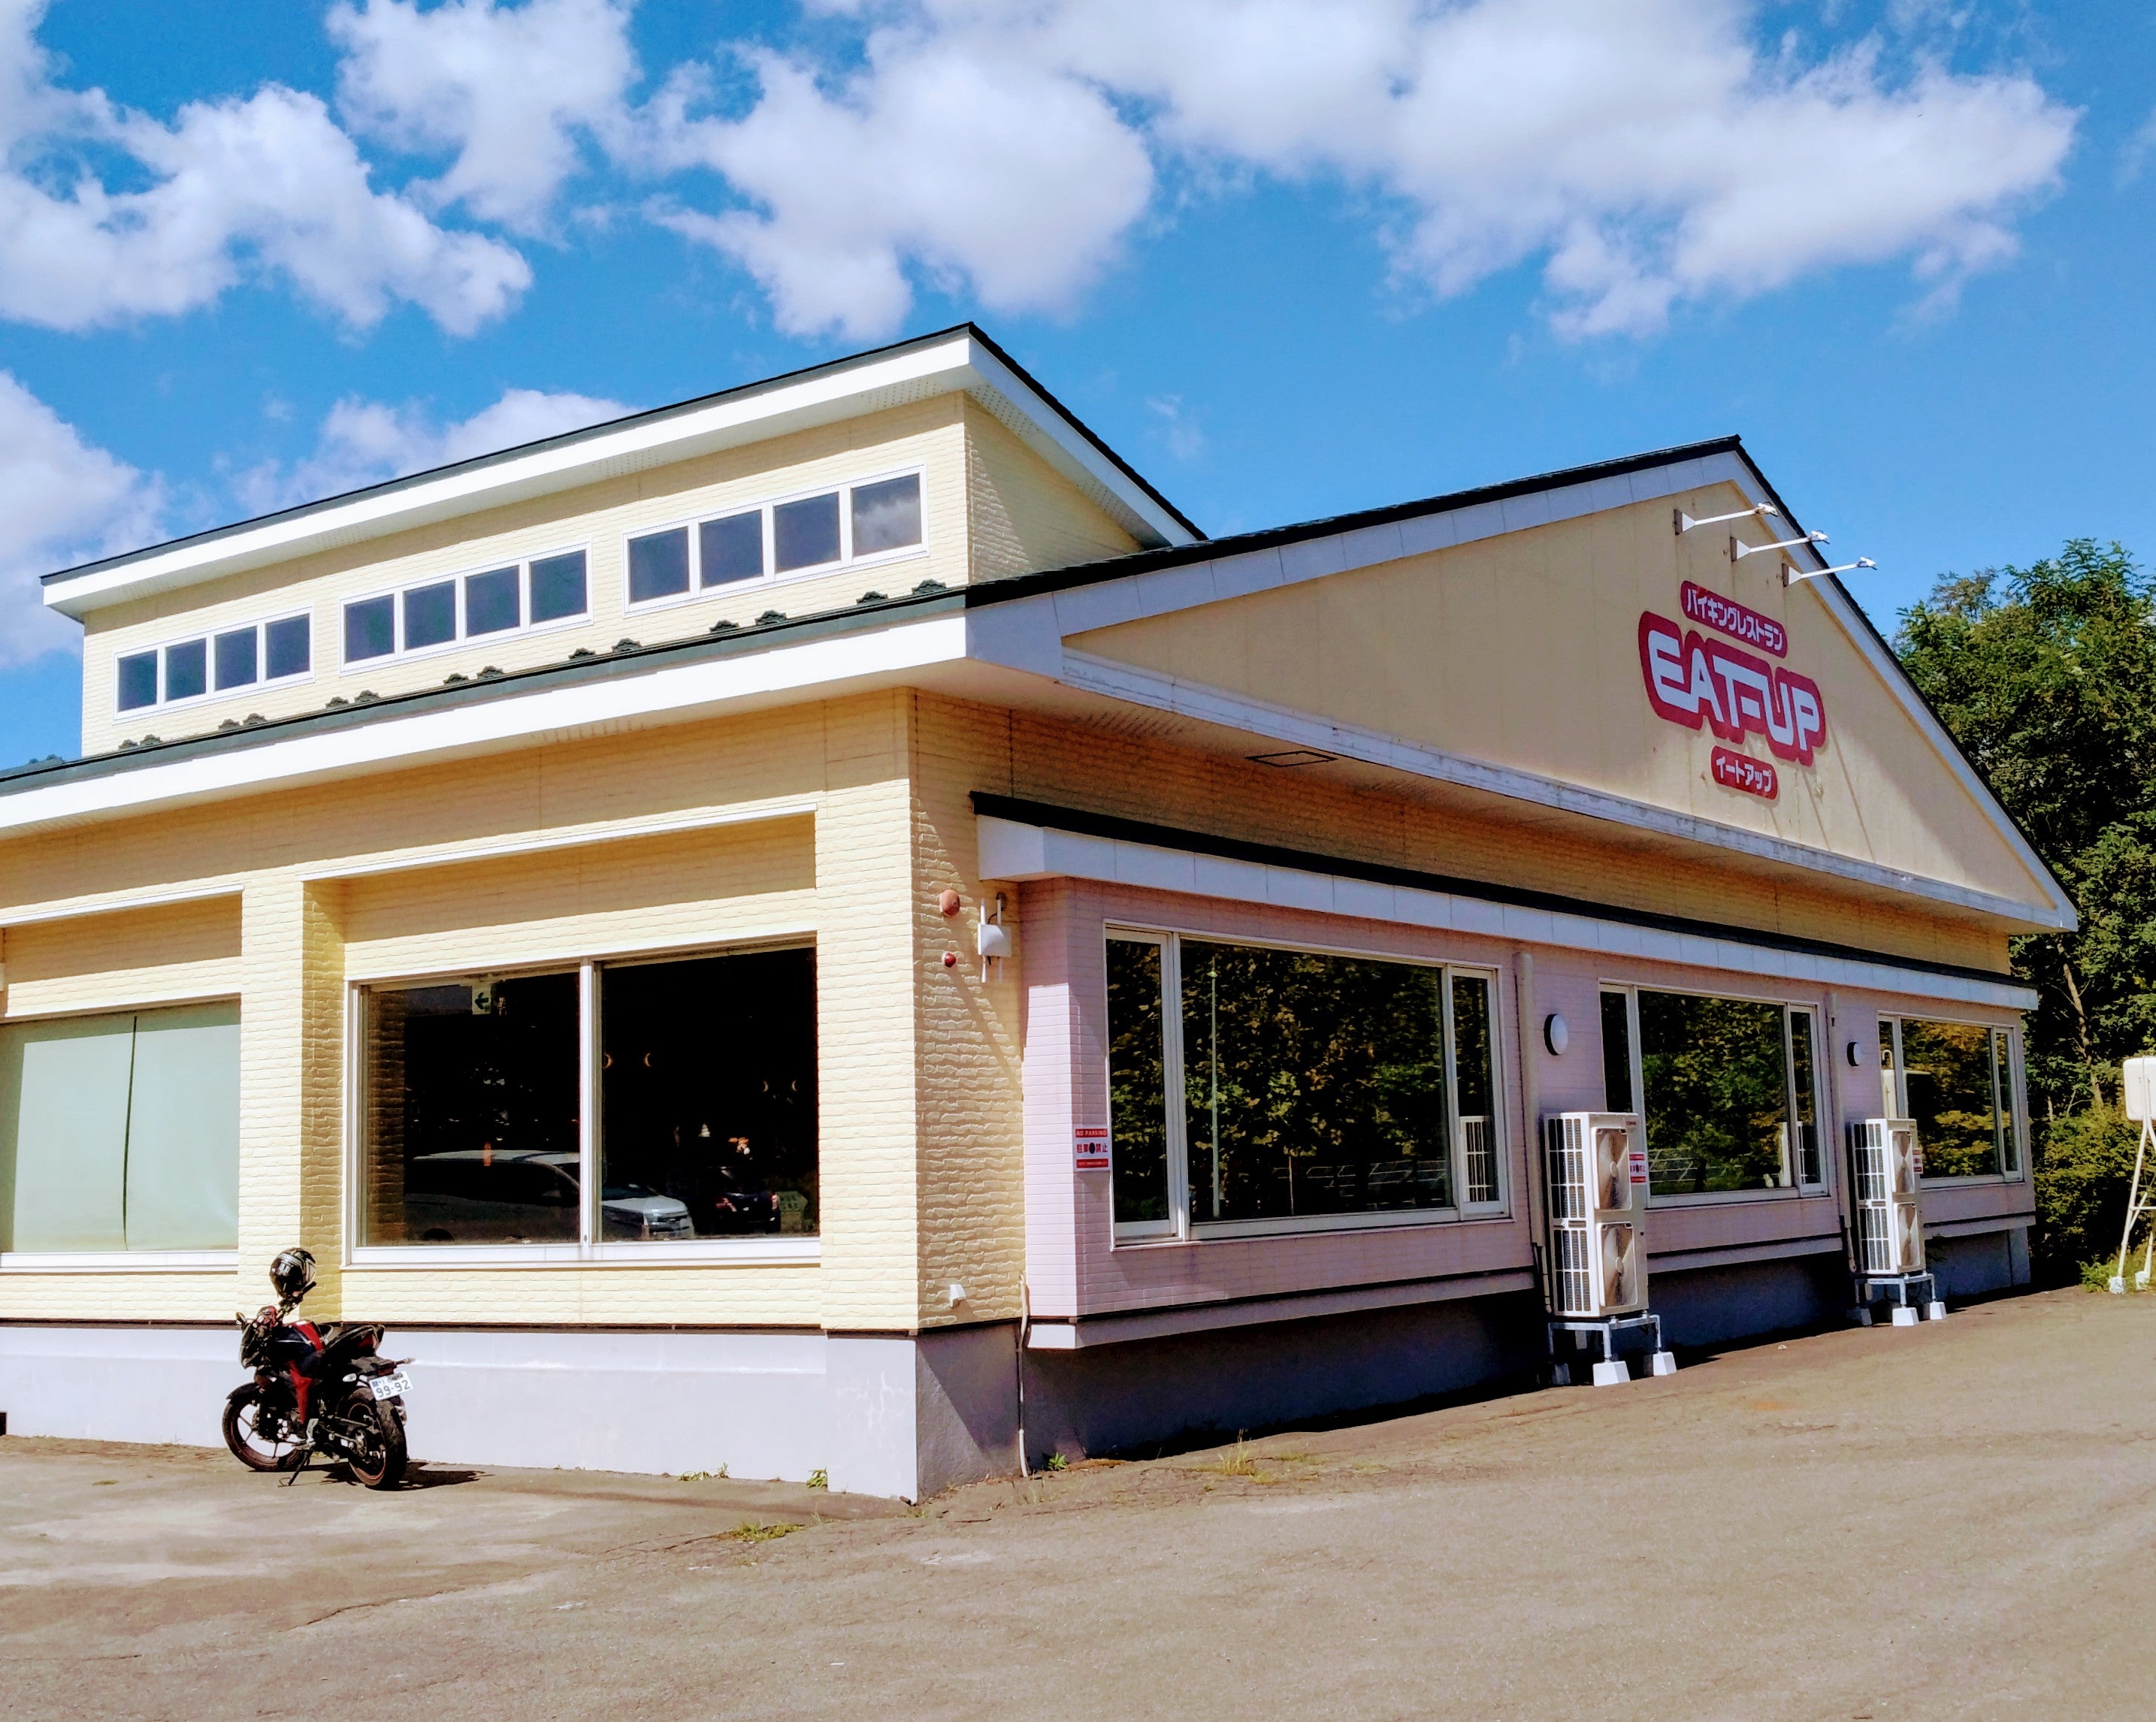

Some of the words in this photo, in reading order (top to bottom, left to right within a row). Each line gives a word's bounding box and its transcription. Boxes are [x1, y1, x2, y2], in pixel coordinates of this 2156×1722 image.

[1686, 588, 1783, 651] バイキングレストラン
[1715, 755, 1772, 793] イートアップ
